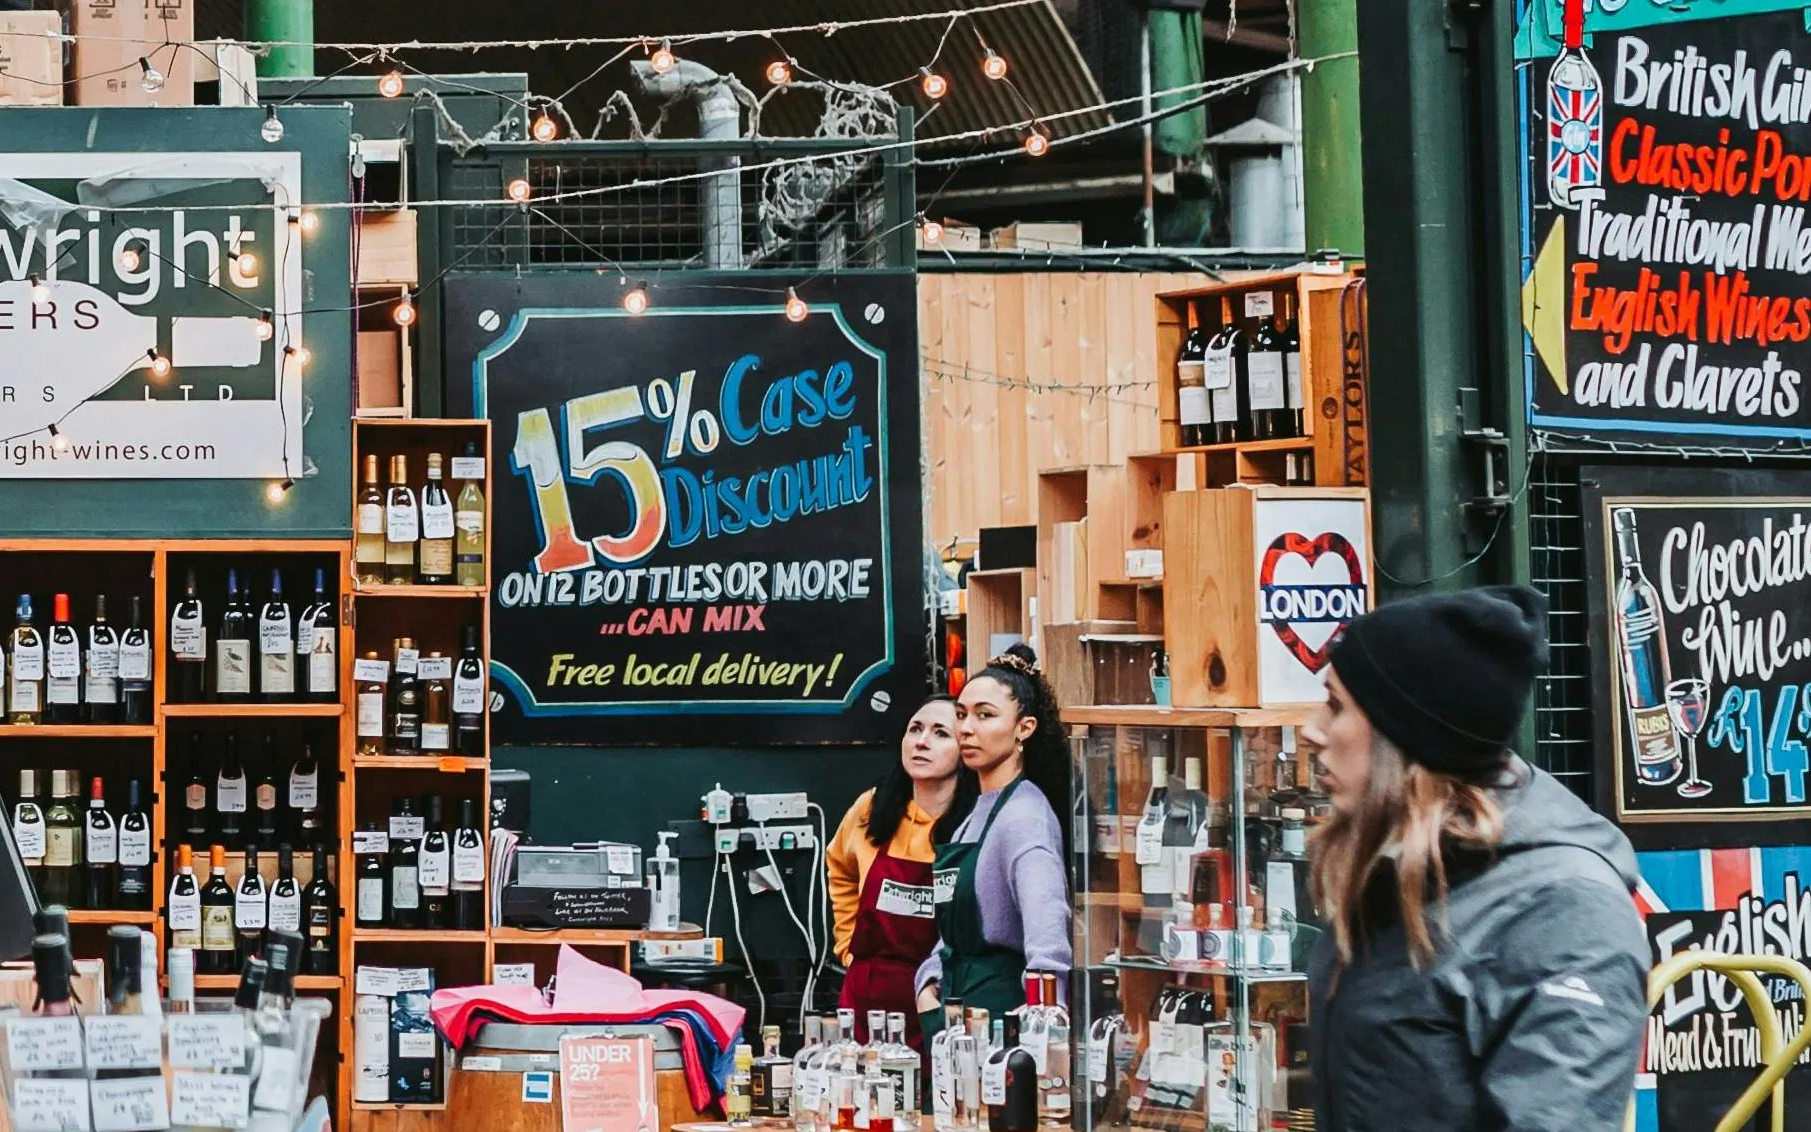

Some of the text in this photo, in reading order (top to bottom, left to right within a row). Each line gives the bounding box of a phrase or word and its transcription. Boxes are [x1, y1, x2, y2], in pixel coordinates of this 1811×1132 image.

[1615, 36, 1758, 130] British
[1610, 117, 1746, 194] Classic
[1569, 186, 1763, 274] Traditional
[1570, 262, 1810, 355] English Wines
[719, 353, 857, 447] Case
[1574, 344, 1801, 418] and Clarets
[509, 370, 719, 575] 15%
[660, 425, 874, 548] Discount
[500, 571, 541, 607] ON
[543, 572, 577, 604] 12
[772, 558, 874, 602] MORE
[702, 605, 768, 634] MIX
[1259, 588, 1366, 621] LONDON
[546, 651, 845, 698] Free local delivery!
[568, 1043, 632, 1064] UNDER
[568, 1063, 600, 1082] 25?
[1646, 1014, 1702, 1075] Mead
[1702, 1012, 1722, 1069] &
[1721, 1010, 1762, 1068] Fru
